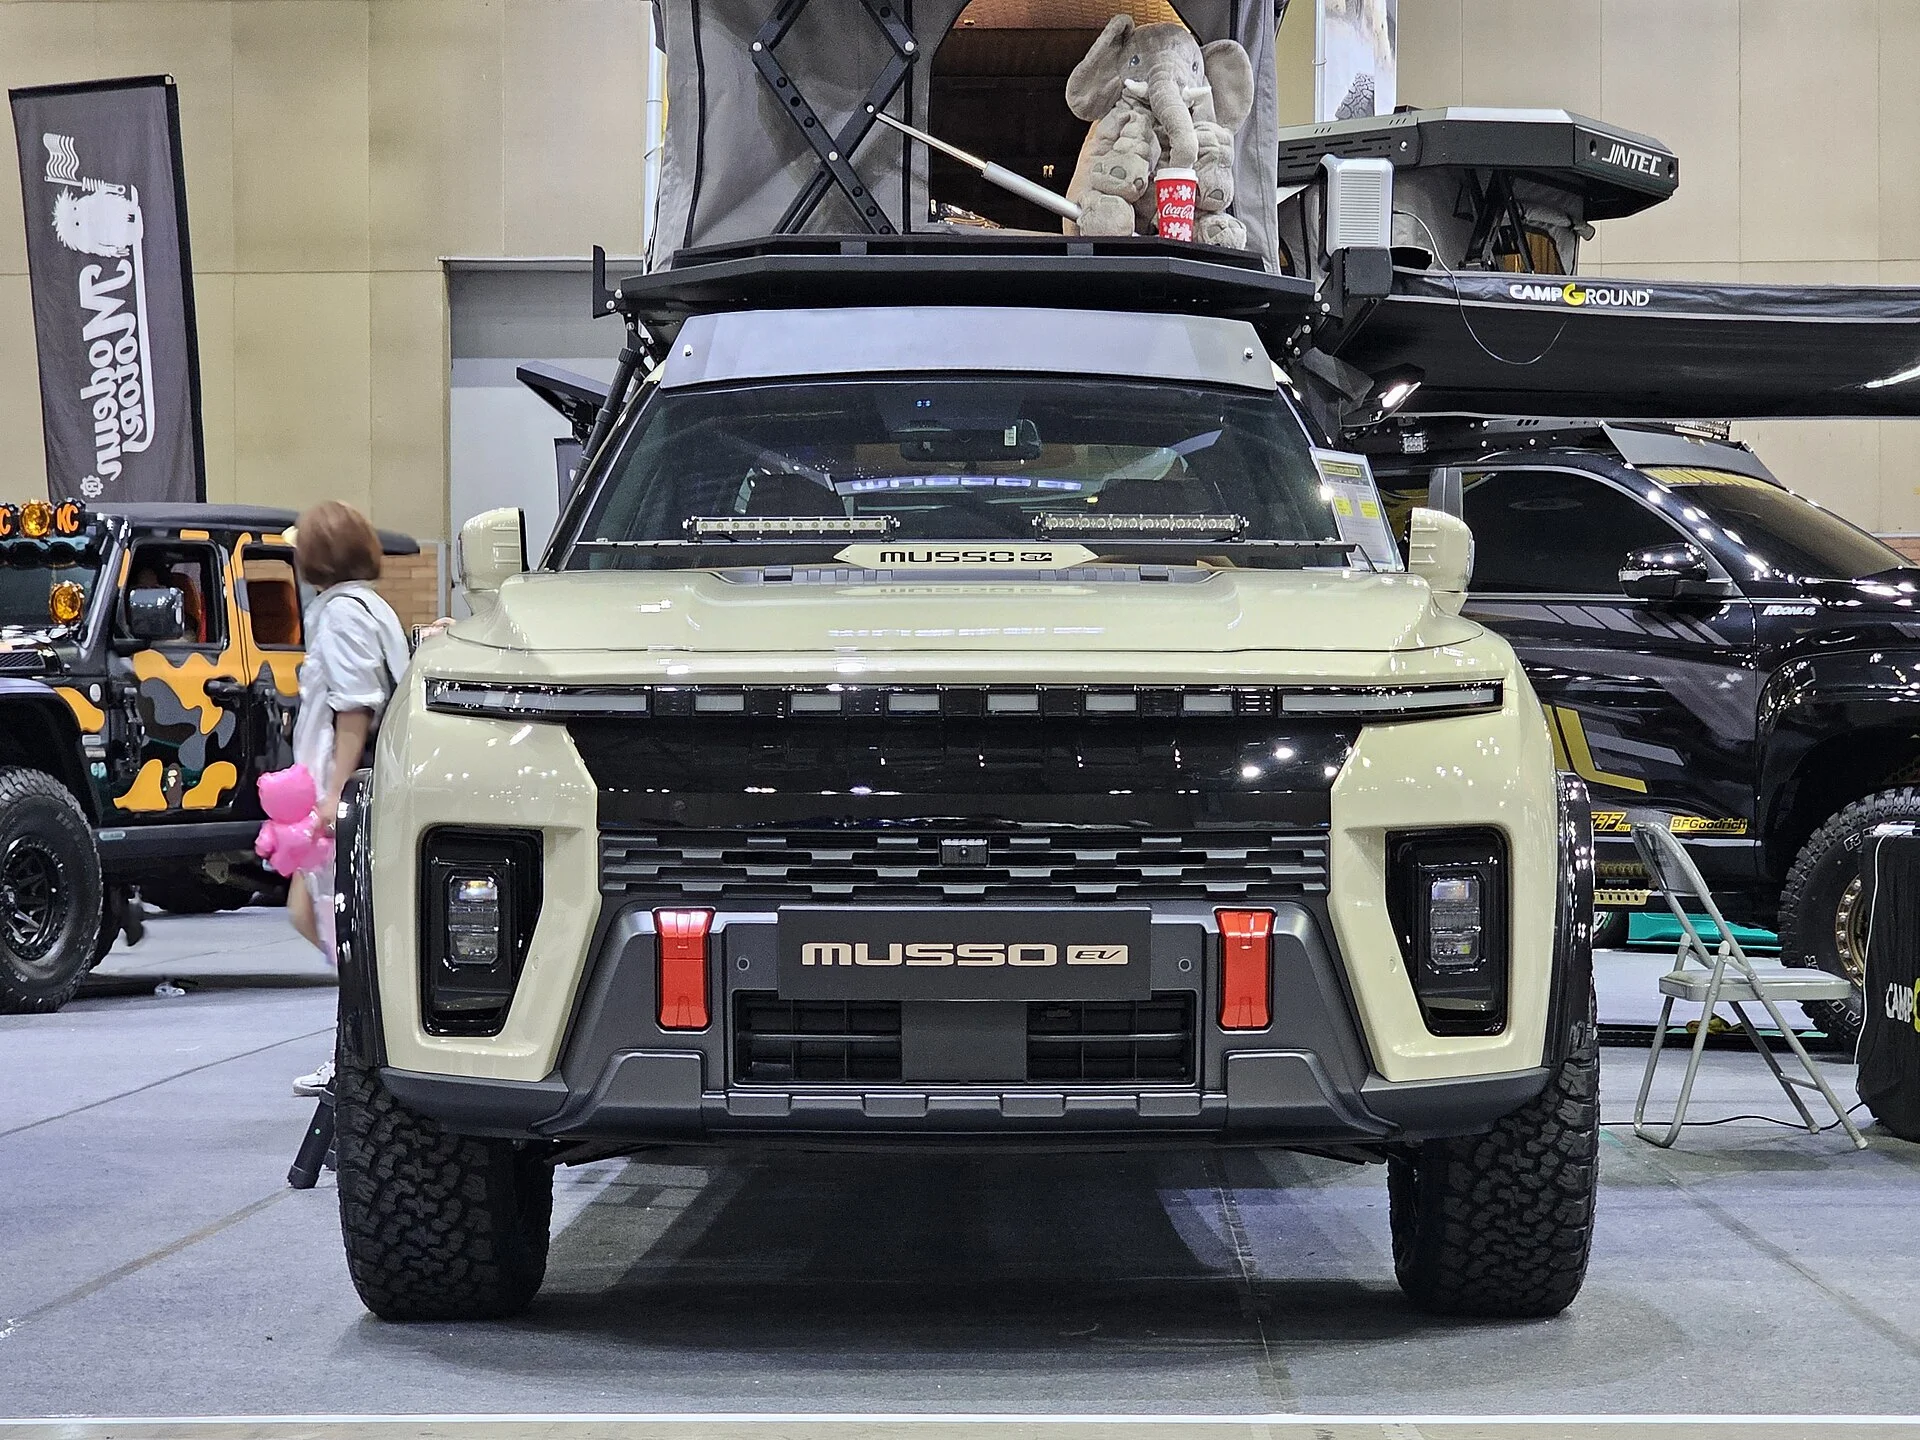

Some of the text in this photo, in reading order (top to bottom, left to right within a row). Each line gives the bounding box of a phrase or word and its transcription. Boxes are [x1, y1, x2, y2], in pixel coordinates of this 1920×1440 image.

[1602, 144, 1661, 176] JINTEC
[1510, 283, 1650, 306] CAMPGROUND
[57, 503, 79, 533] KC
[880, 551, 1014, 563] MUSSO
[1672, 818, 1746, 830] BFGoodrich
[802, 943, 1122, 966] MUSSO EV
